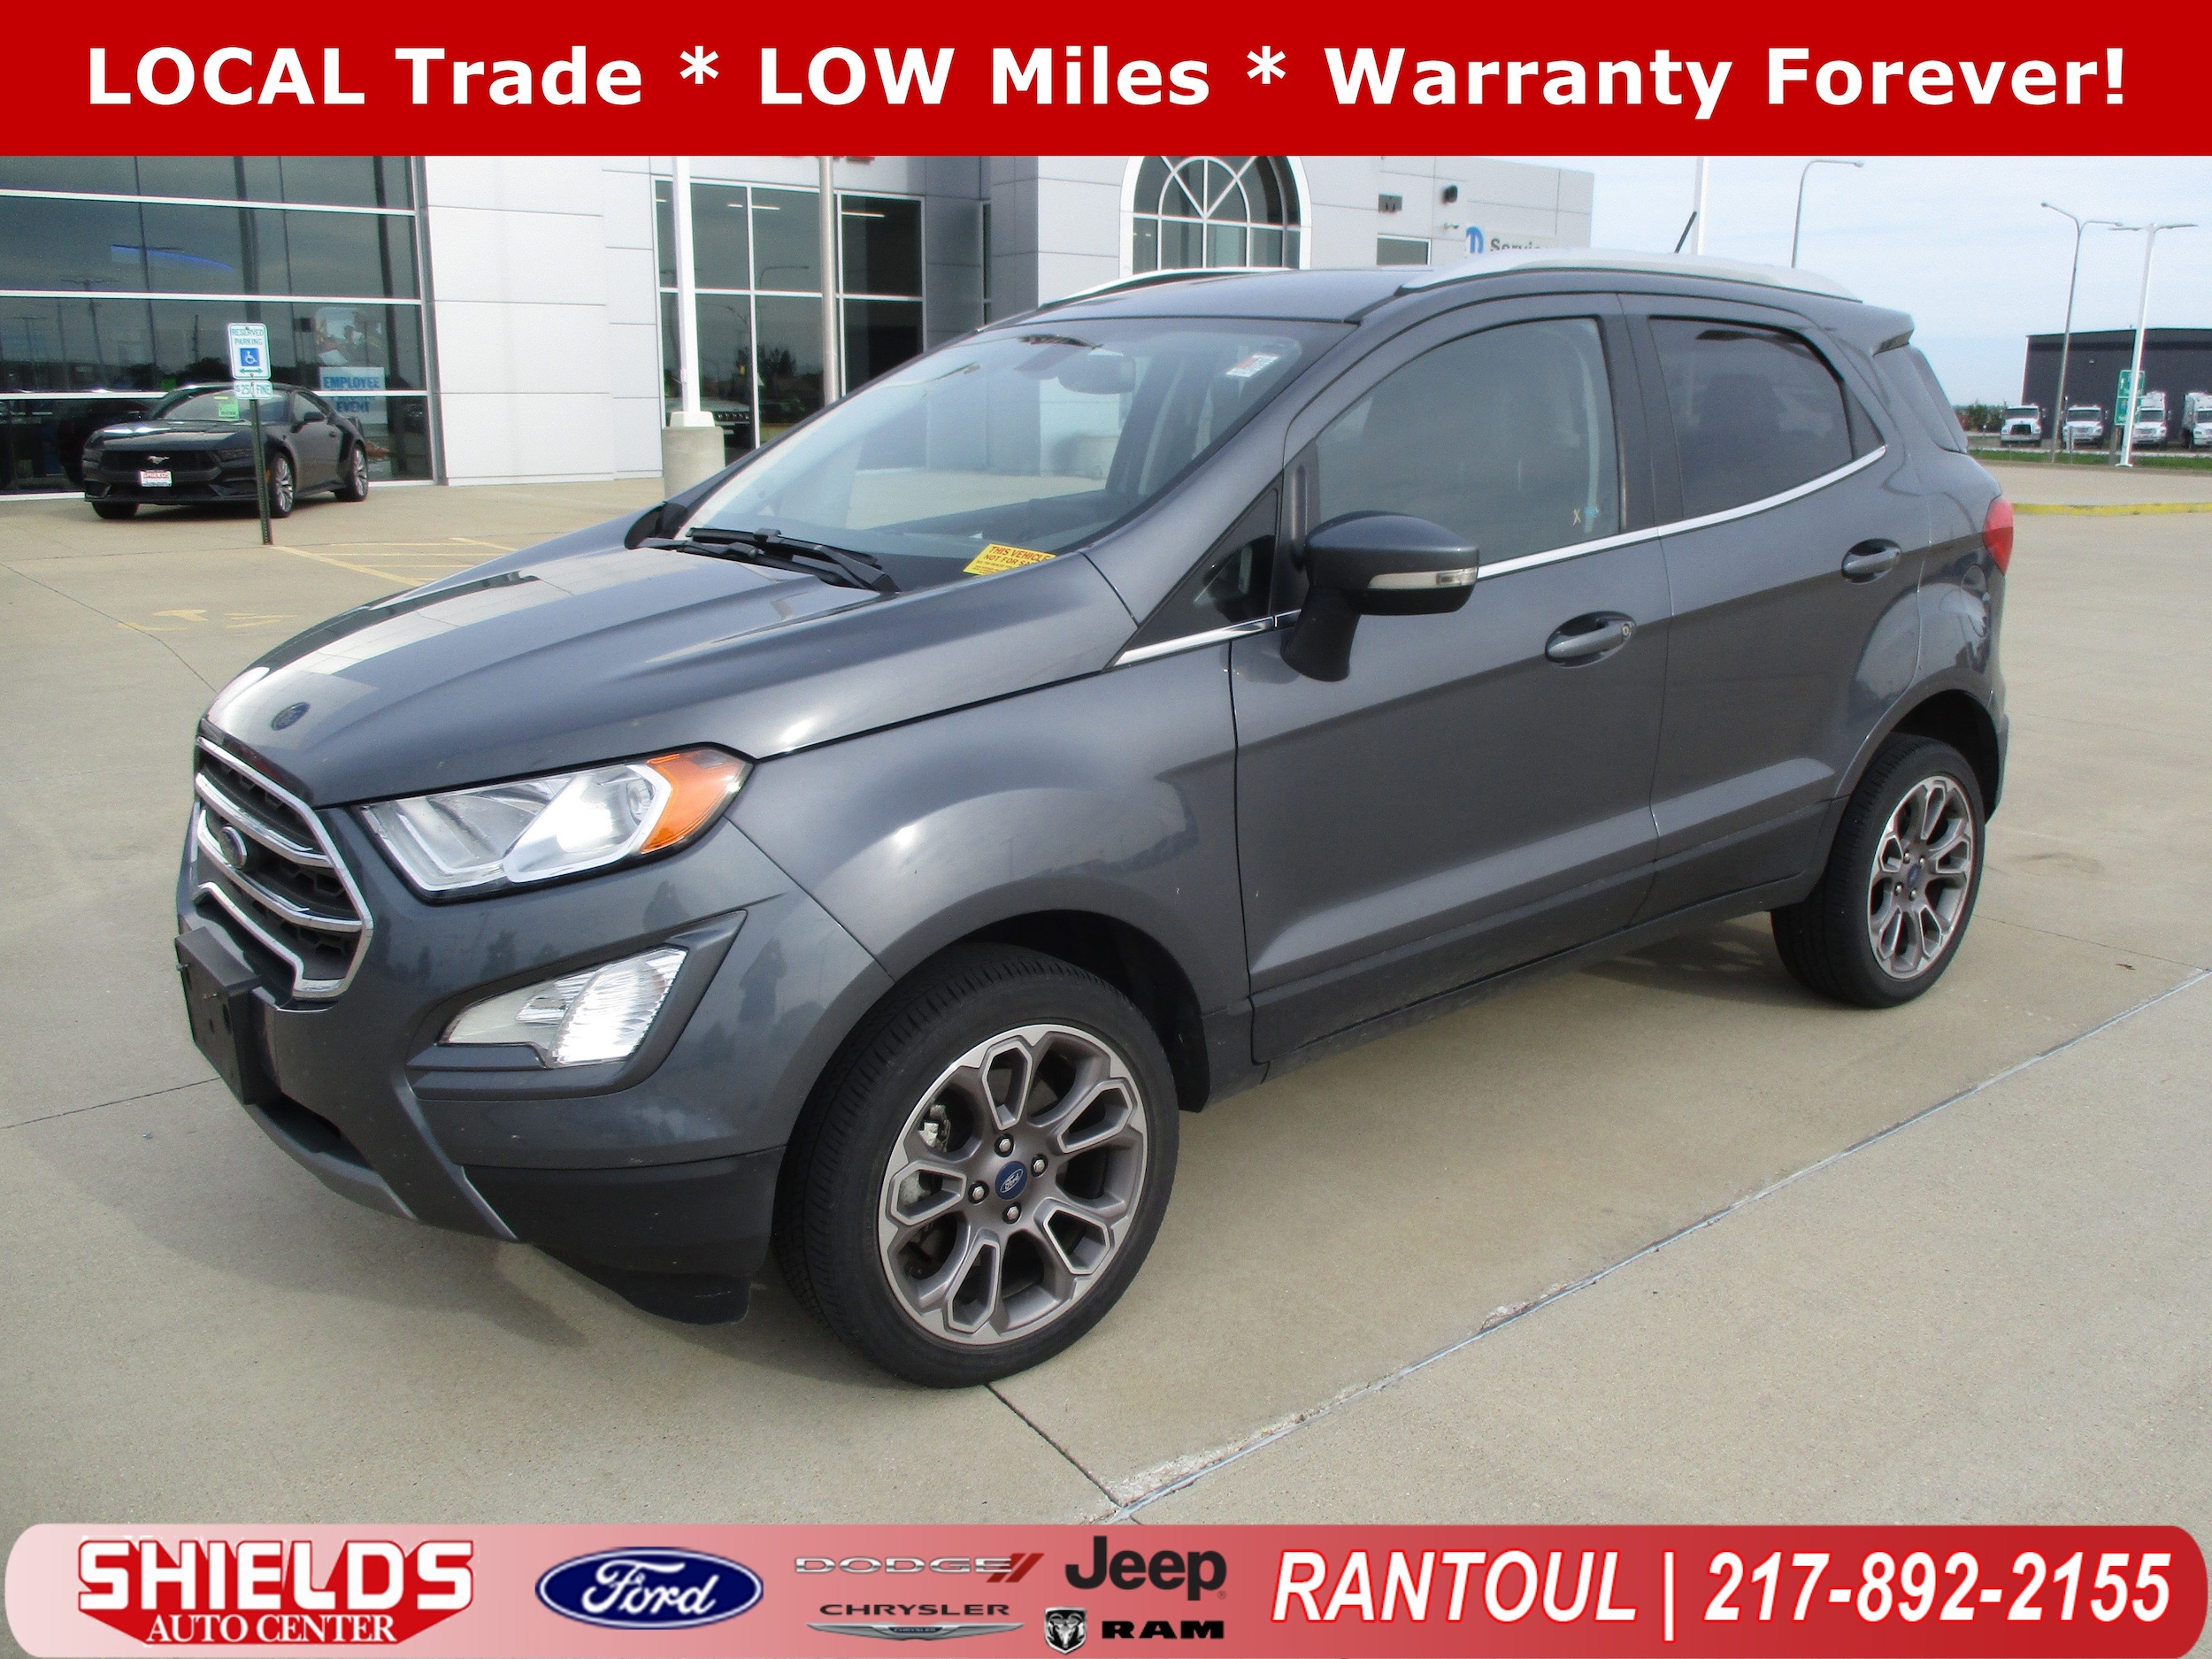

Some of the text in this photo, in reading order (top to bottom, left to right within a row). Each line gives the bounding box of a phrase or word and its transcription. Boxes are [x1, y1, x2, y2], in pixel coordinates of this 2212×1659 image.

[322, 376, 380, 388] EMPLOYEE
[256, 384, 272, 395] FINE
[336, 401, 370, 412] EVENT
[988, 546, 1010, 556] THIS
